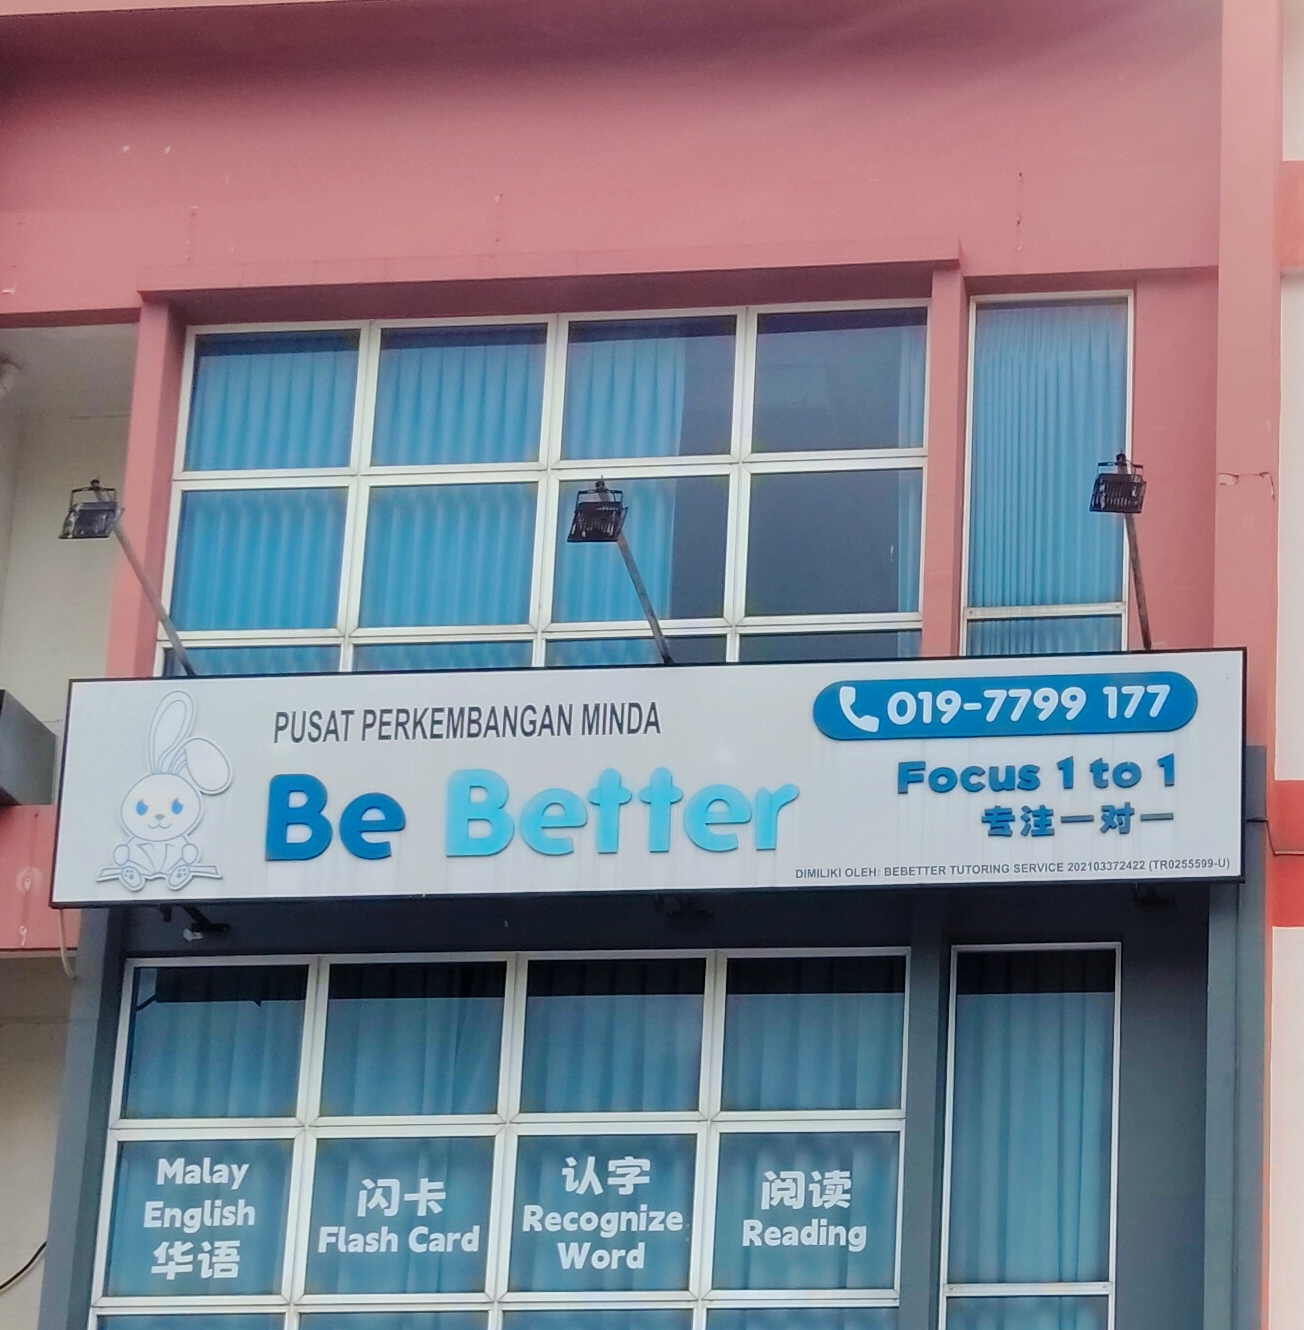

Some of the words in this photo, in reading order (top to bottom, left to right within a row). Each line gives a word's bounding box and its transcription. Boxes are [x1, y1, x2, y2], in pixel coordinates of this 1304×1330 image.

[273, 709, 355, 745] PUSAT
[361, 704, 574, 743] PERKEMBANGAN
[581, 701, 661, 737] MINDA
[887, 686, 1086, 726] 019-7799
[1103, 684, 1171, 719] 177
[897, 759, 1041, 794] Focus
[1056, 755, 1075, 790] 1
[1089, 757, 1142, 790] to
[1157, 753, 1176, 788] 1
[265, 773, 406, 862] Be
[445, 766, 800, 857] Better
[981, 801, 1175, 838] 专注一对一
[795, 866, 842, 879] DIMILIKI
[845, 866, 880, 878] OLEH:
[884, 865, 947, 877] BEBETTER
[950, 863, 1010, 875] TUTORING
[1013, 862, 1064, 873] SERVICE
[1067, 860, 1146, 872] 202103372422
[156, 1157, 250, 1190] Malay
[561, 1155, 651, 1196] 认字
[760, 1170, 852, 1211] 阅读
[143, 1199, 256, 1234] English
[356, 1177, 447, 1218] 闪卡
[317, 1225, 399, 1254] Flash
[408, 1225, 481, 1253] Card
[522, 1204, 684, 1238] Recognize
[742, 1219, 868, 1252] Reading
[151, 1239, 241, 1281] 华语
[557, 1242, 646, 1270] Word
